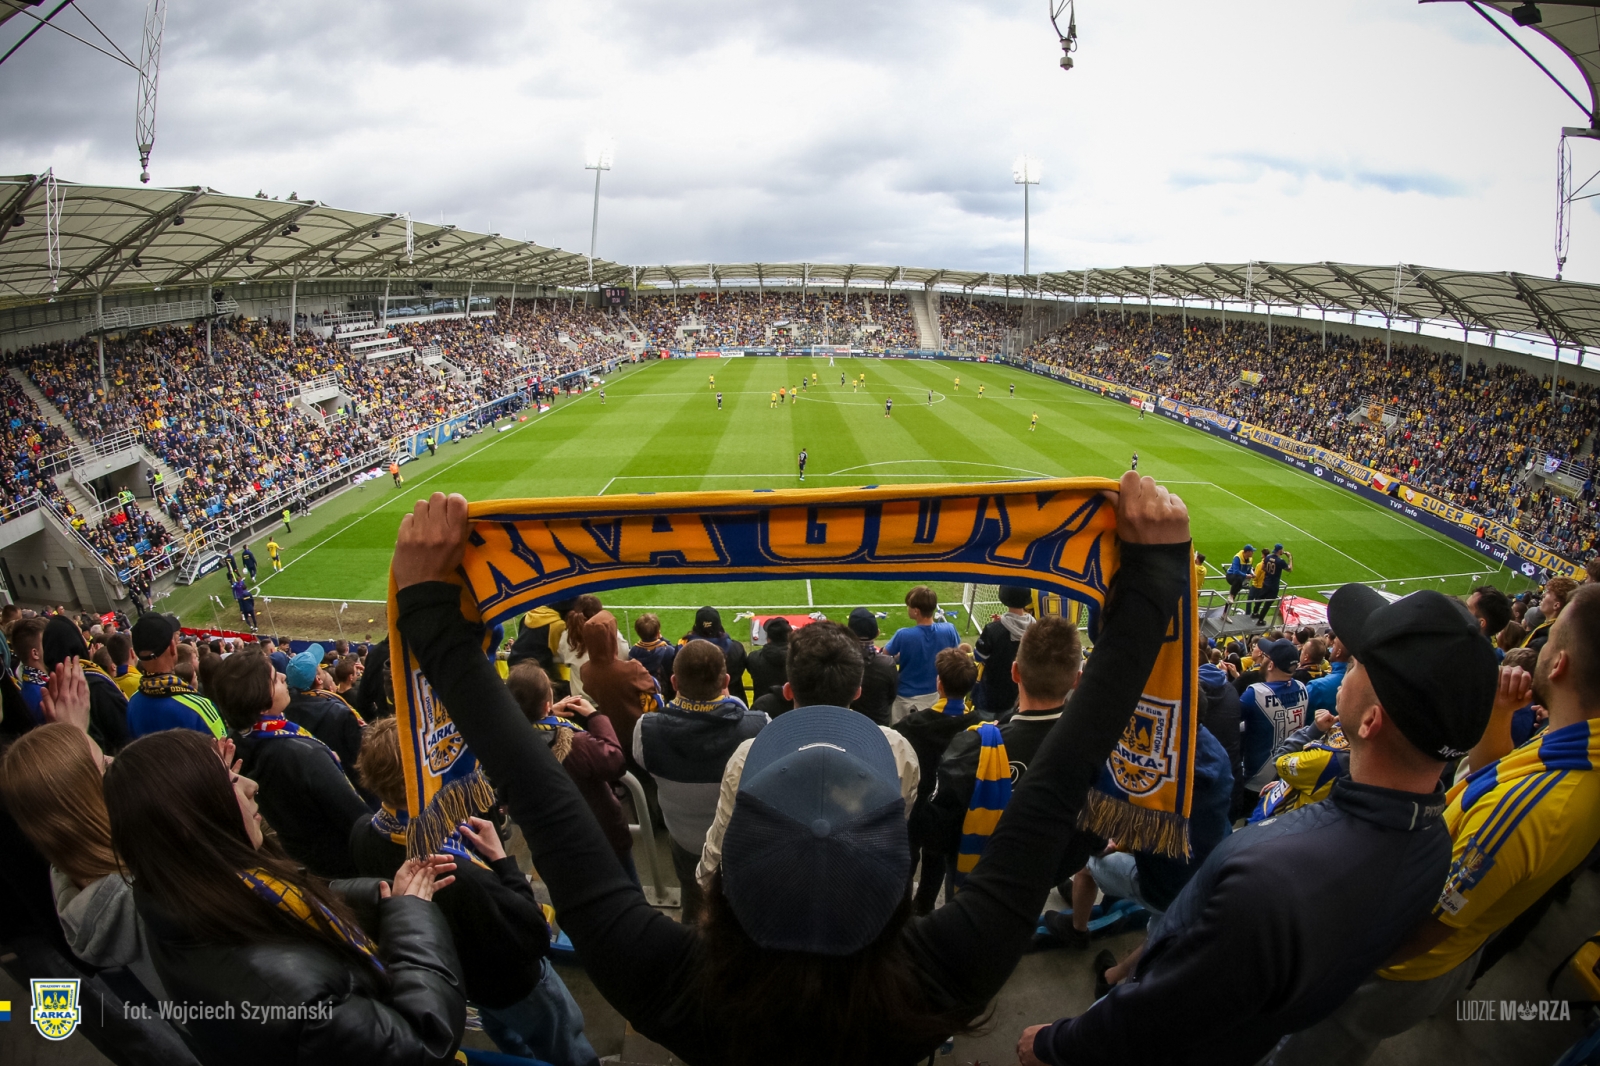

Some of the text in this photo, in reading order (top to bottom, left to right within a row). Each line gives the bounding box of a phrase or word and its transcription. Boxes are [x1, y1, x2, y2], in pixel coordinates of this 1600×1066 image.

[1240, 437, 1248, 445] info
[1296, 458, 1306, 468] info
[1341, 462, 1368, 479] GDYNIA
[82, 469, 87, 477] A
[1334, 475, 1358, 490] TVP info
[1390, 500, 1402, 510] TVP
[1405, 506, 1418, 517] info
[1421, 496, 1464, 522] SUPER
[1471, 517, 1510, 544] ARKA
[1517, 541, 1575, 576] GDYNIA
[1476, 540, 1508, 561] TVP info
[1267, 562, 1275, 574] 09
[430, 722, 457, 747] ARK
